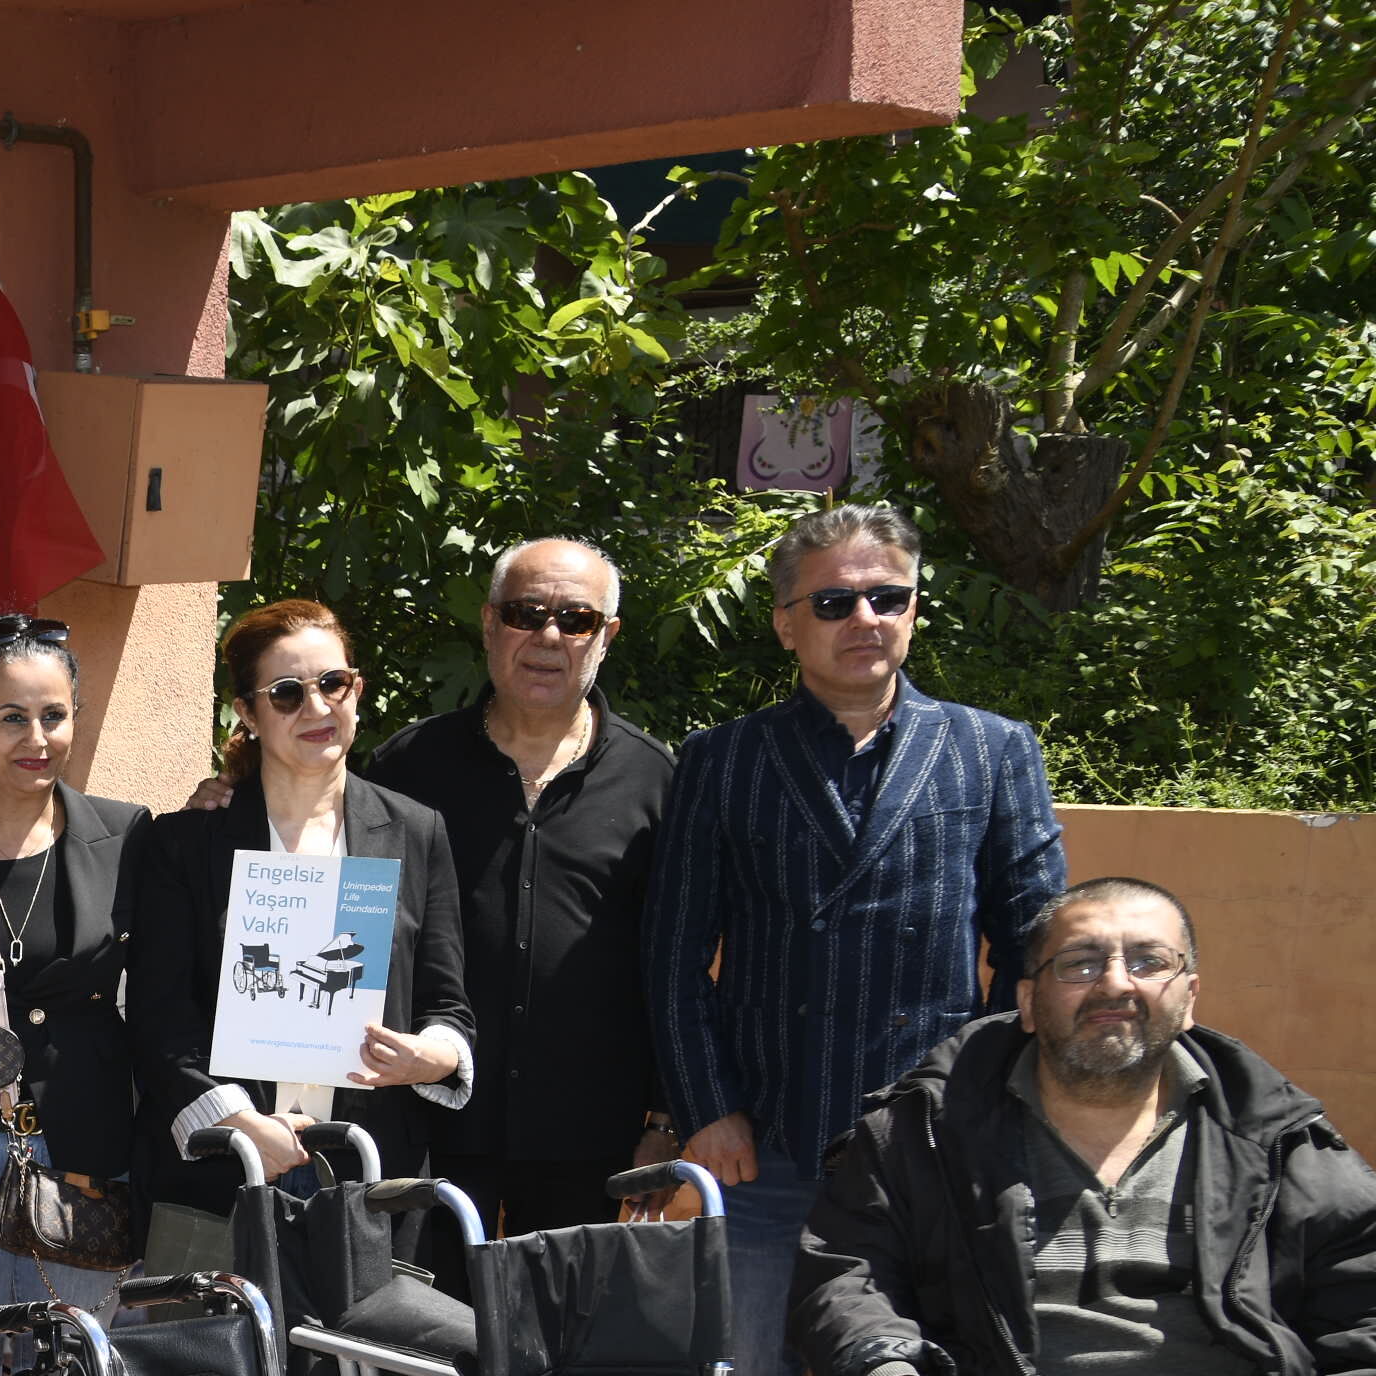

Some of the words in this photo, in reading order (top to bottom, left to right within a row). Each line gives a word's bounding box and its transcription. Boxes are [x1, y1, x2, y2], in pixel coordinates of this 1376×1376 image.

[247, 862, 325, 885] Engelsiz
[343, 881, 393, 893] Unimpeded
[245, 889, 307, 911] Yaşam
[344, 893, 360, 902] Life
[340, 903, 389, 914] Foundation
